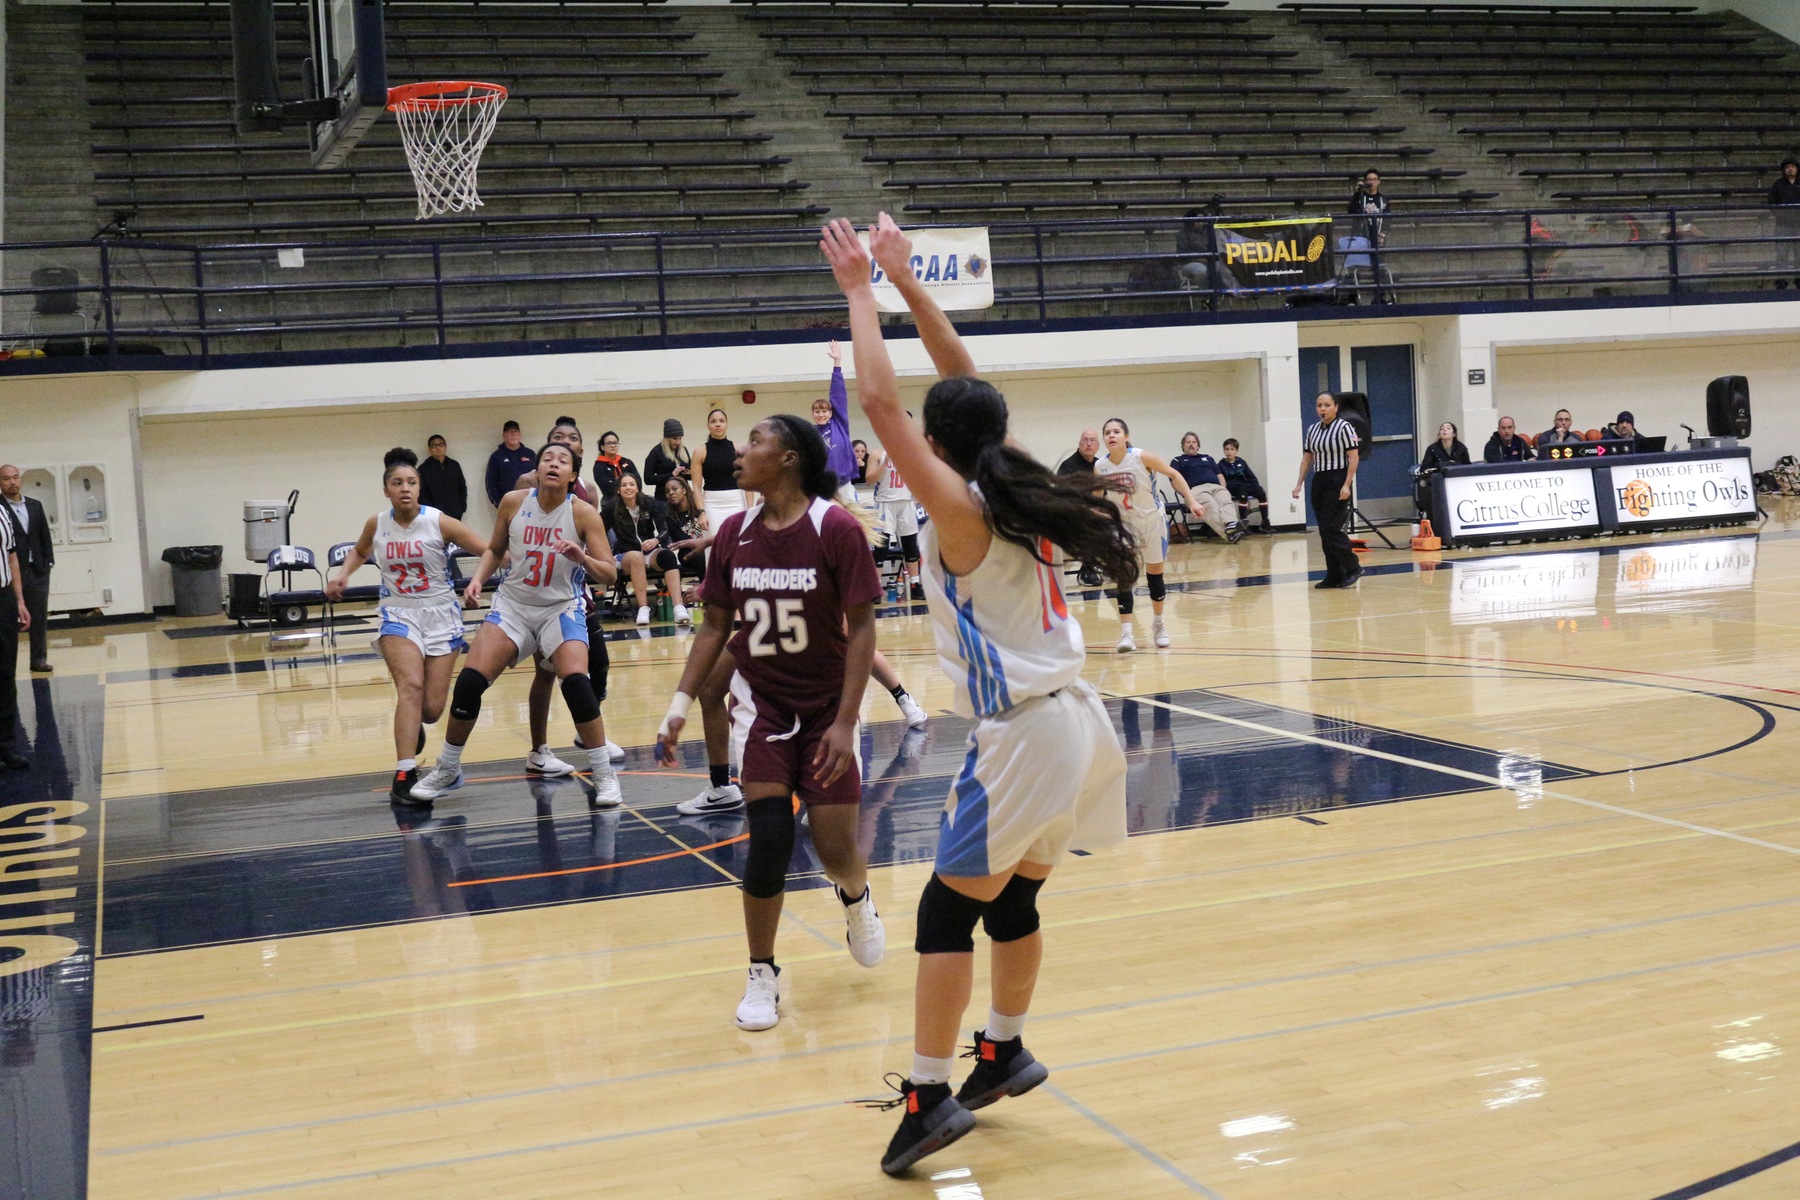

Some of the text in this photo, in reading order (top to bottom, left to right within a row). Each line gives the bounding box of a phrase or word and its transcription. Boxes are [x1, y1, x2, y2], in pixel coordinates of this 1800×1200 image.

[1225, 239, 1306, 265] PEDAL
[870, 254, 958, 284] CCAA
[1475, 476, 1564, 492] WELCOME TO
[1635, 462, 1724, 479] HOME OF THE
[1456, 492, 1591, 524] Citrus College
[1616, 475, 1749, 517] Fighting Owls
[386, 540, 423, 560] OWLS
[523, 525, 563, 547] OWLS
[389, 562, 430, 595] 23
[523, 550, 555, 587] 31
[732, 567, 818, 593] MARAUDERS
[744, 597, 809, 658] 25
